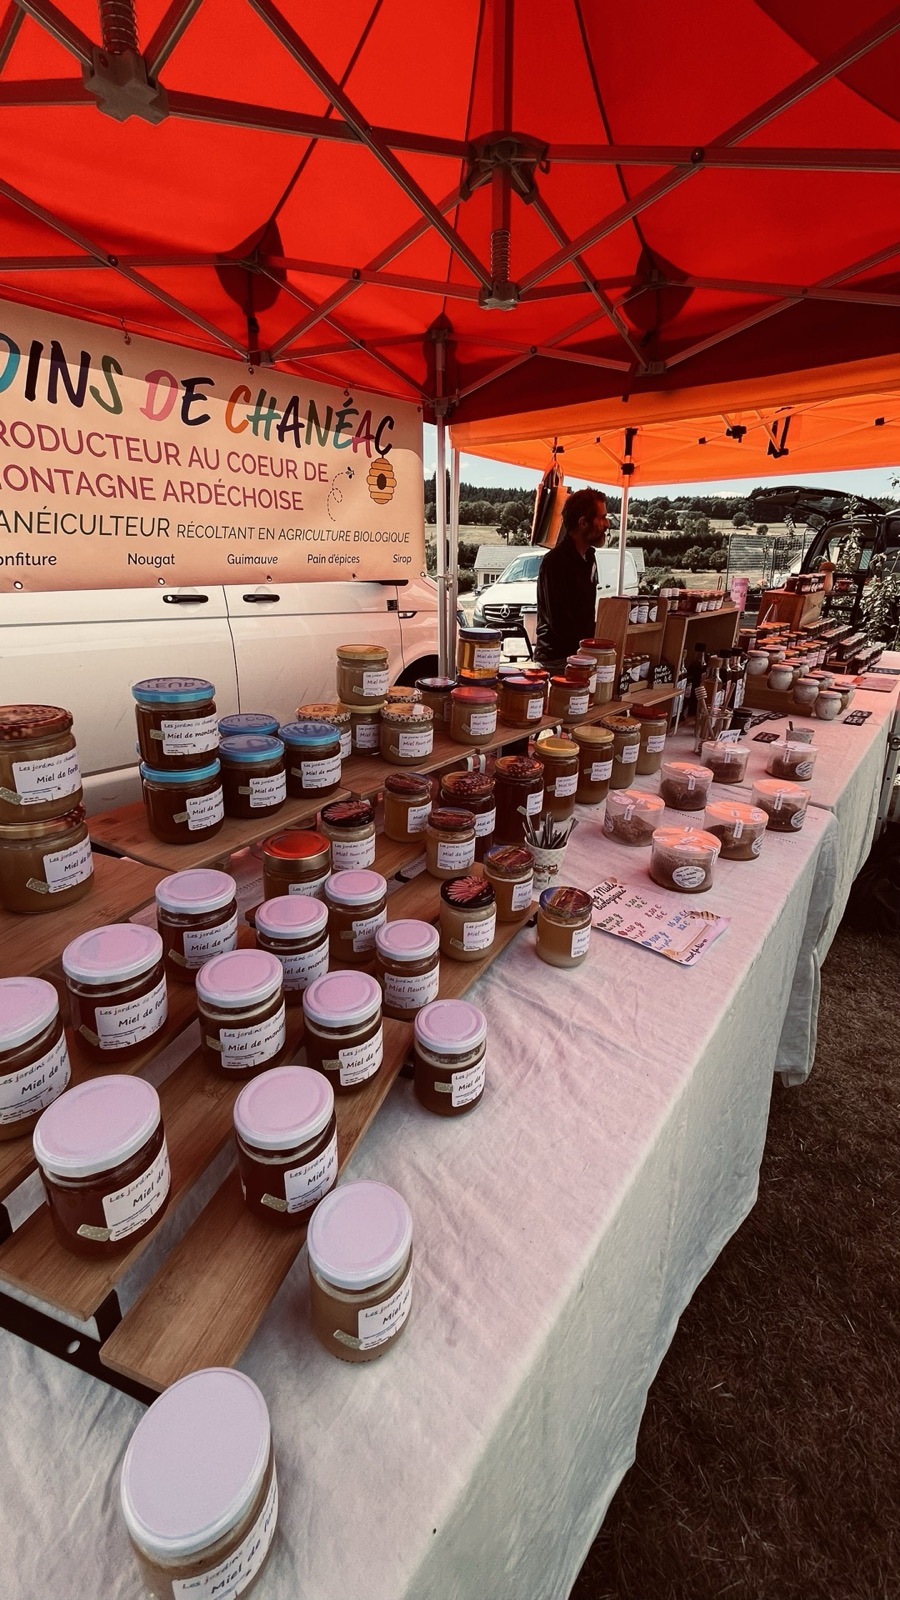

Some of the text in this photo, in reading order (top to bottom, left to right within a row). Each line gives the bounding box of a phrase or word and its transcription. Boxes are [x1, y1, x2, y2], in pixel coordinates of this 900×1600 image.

[139, 369, 215, 426] DE
[225, 385, 395, 459] CHANÉAC
[188, 445, 220, 470] AU
[227, 451, 299, 480] COEUR
[304, 462, 329, 483] DE
[0, 464, 304, 511] ONTAGNE ARDÉCHOISE
[177, 521, 255, 540] RÉCOLTANT
[258, 527, 276, 540] EN
[278, 529, 351, 542] AGRICULTURE
[353, 531, 410, 543] BIOLOGIQUE
[127, 553, 176, 568] Nougat
[227, 553, 278, 565] Guimauve
[307, 553, 360, 565] Pain d'épices
[392, 554, 412, 565] Sirop
[174, 722, 194, 730] jardins
[32, 762, 55, 772] jardins
[36, 772, 55, 784] Miel
[58, 770, 66, 779] de
[50, 851, 78, 863] Les jardins
[64, 855, 86, 872] Miel de
[301, 884, 318, 892] jardins
[199, 929, 220, 939] jardins
[358, 927, 373, 936] Miel
[191, 942, 209, 951] Miel
[212, 940, 221, 948] de
[284, 955, 305, 964] jardins
[284, 967, 294, 975] iel
[388, 983, 425, 993] Miel fleurs
[113, 1002, 140, 1016] jardins
[118, 1013, 139, 1027] Miel
[143, 1008, 153, 1018] de
[237, 1028, 261, 1039] jardins
[228, 1042, 248, 1051] Miel
[250, 1040, 261, 1049] de
[354, 1042, 374, 1056] jardins
[346, 1053, 374, 1069] Miel de
[15, 1062, 45, 1083] jardins
[21, 1065, 58, 1095] Miel de
[458, 1080, 473, 1091] Miel
[289, 1154, 326, 1178] Les jardins
[307, 1157, 334, 1185] Miel de
[110, 1169, 153, 1203] Les jardins
[133, 1182, 154, 1207] Miel
[365, 1291, 403, 1318] Les jardins
[382, 1302, 402, 1325] Miel
[204, 1550, 243, 1585] jardins
[211, 1539, 261, 1594] Miel de
